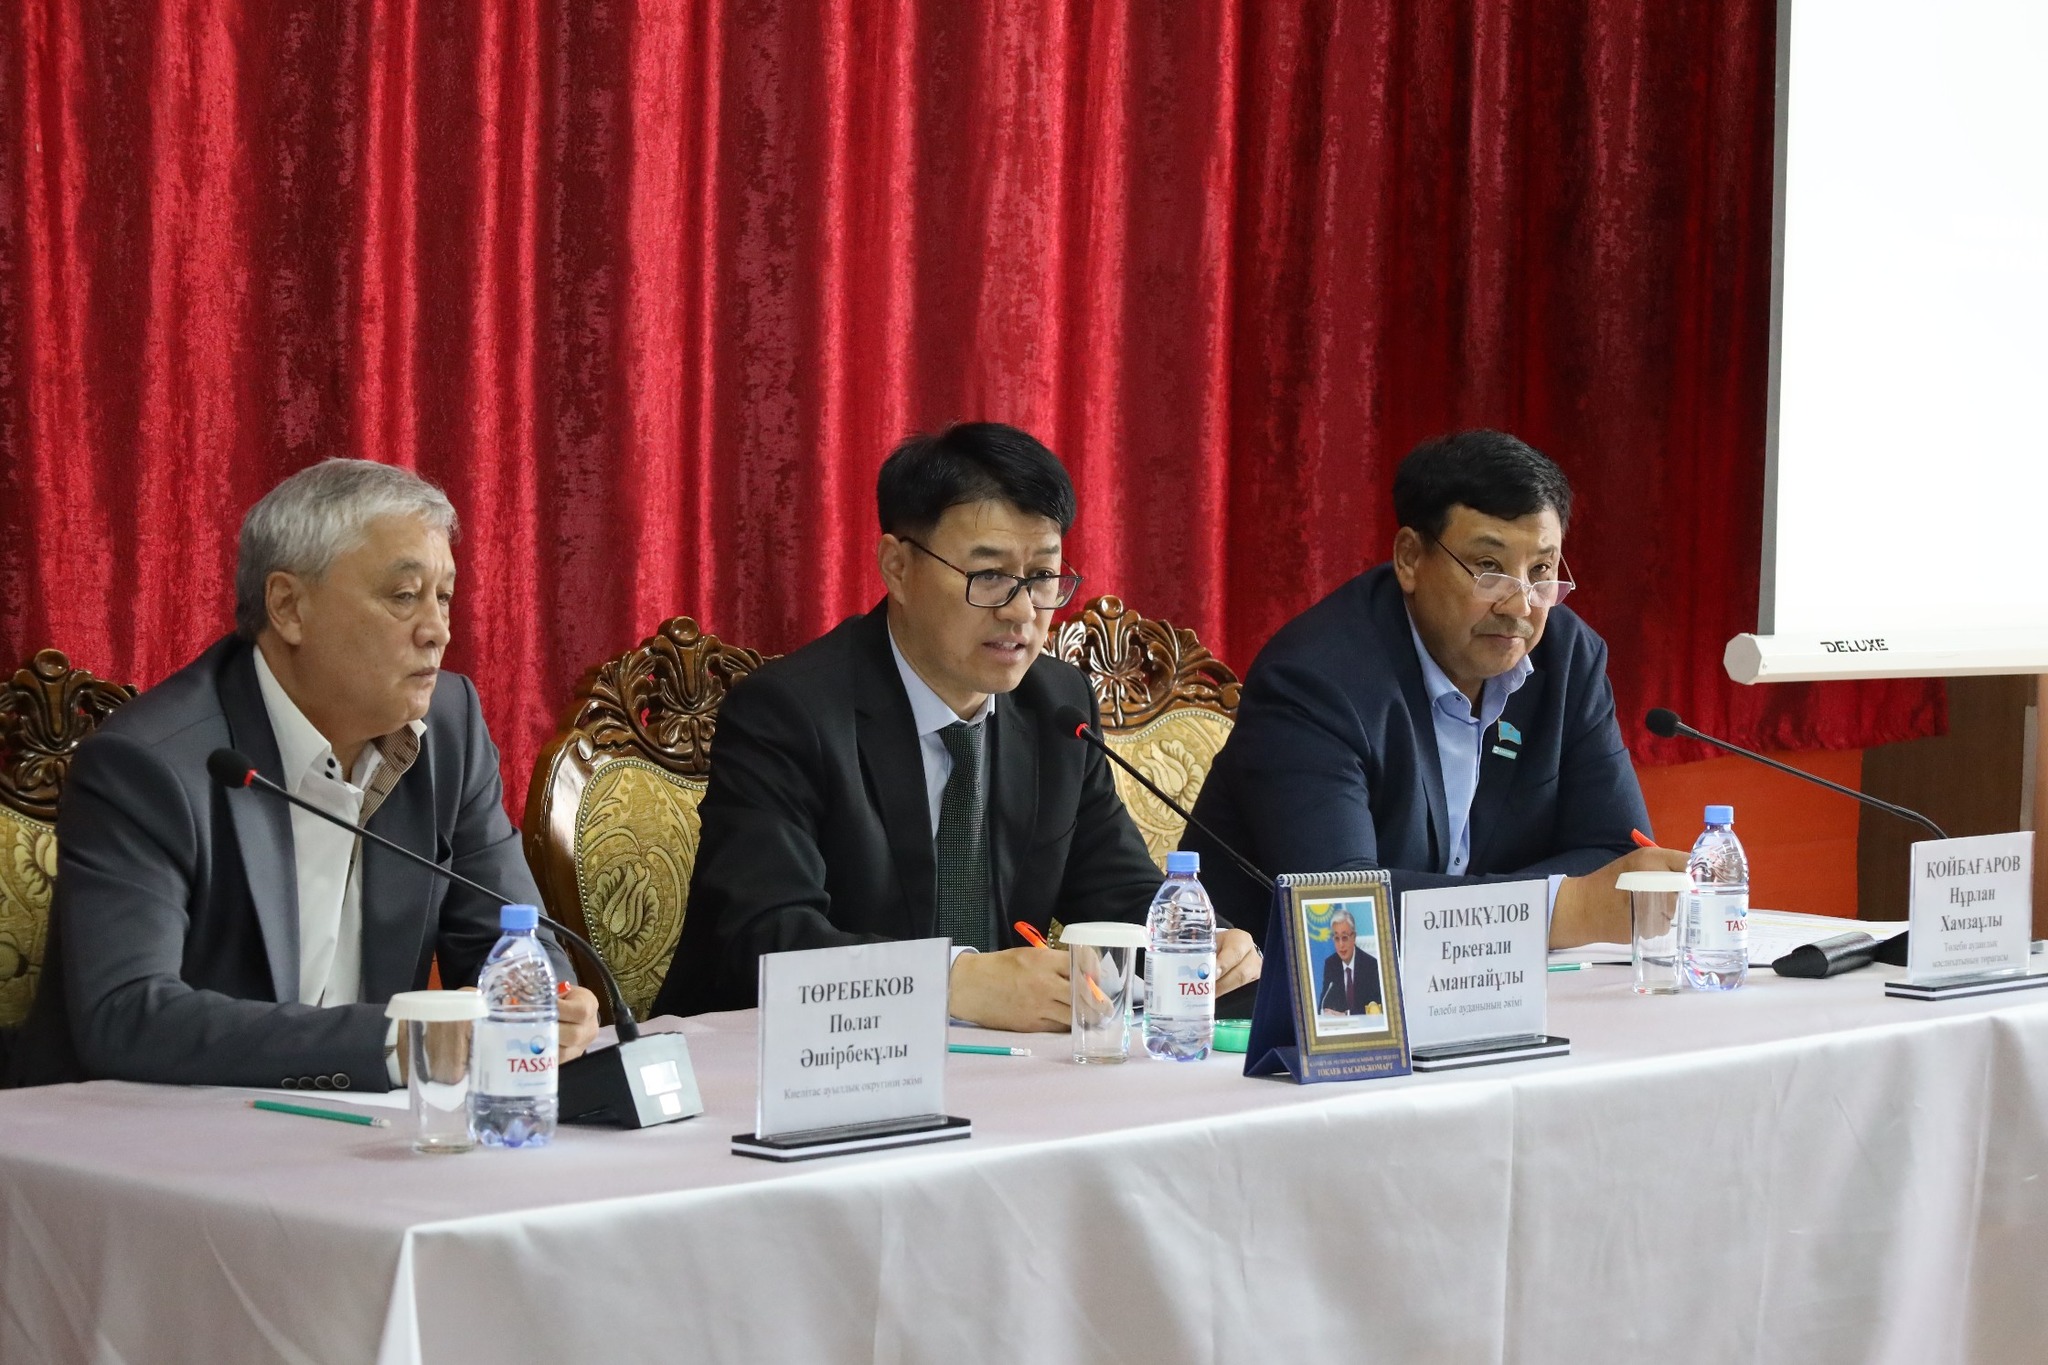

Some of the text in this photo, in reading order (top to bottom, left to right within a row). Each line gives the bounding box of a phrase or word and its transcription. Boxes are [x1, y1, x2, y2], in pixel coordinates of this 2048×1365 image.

[1820, 639, 1889, 653] DELUXE
[1926, 855, 2021, 880] ҚОЙБАҒАРОВ
[1949, 887, 1996, 907] Нұрлан
[1423, 902, 1530, 931] ӘЛІМҚҰЛОВ
[1940, 915, 2002, 933] Хамзаұлы
[1441, 940, 1511, 964] Еркеғали
[798, 976, 914, 1004] ТӨРЕБЕКОВ
[1427, 968, 1524, 993] Амантайұлы
[829, 1013, 882, 1033] Полат
[800, 1043, 907, 1070] Әшірбекұлы
